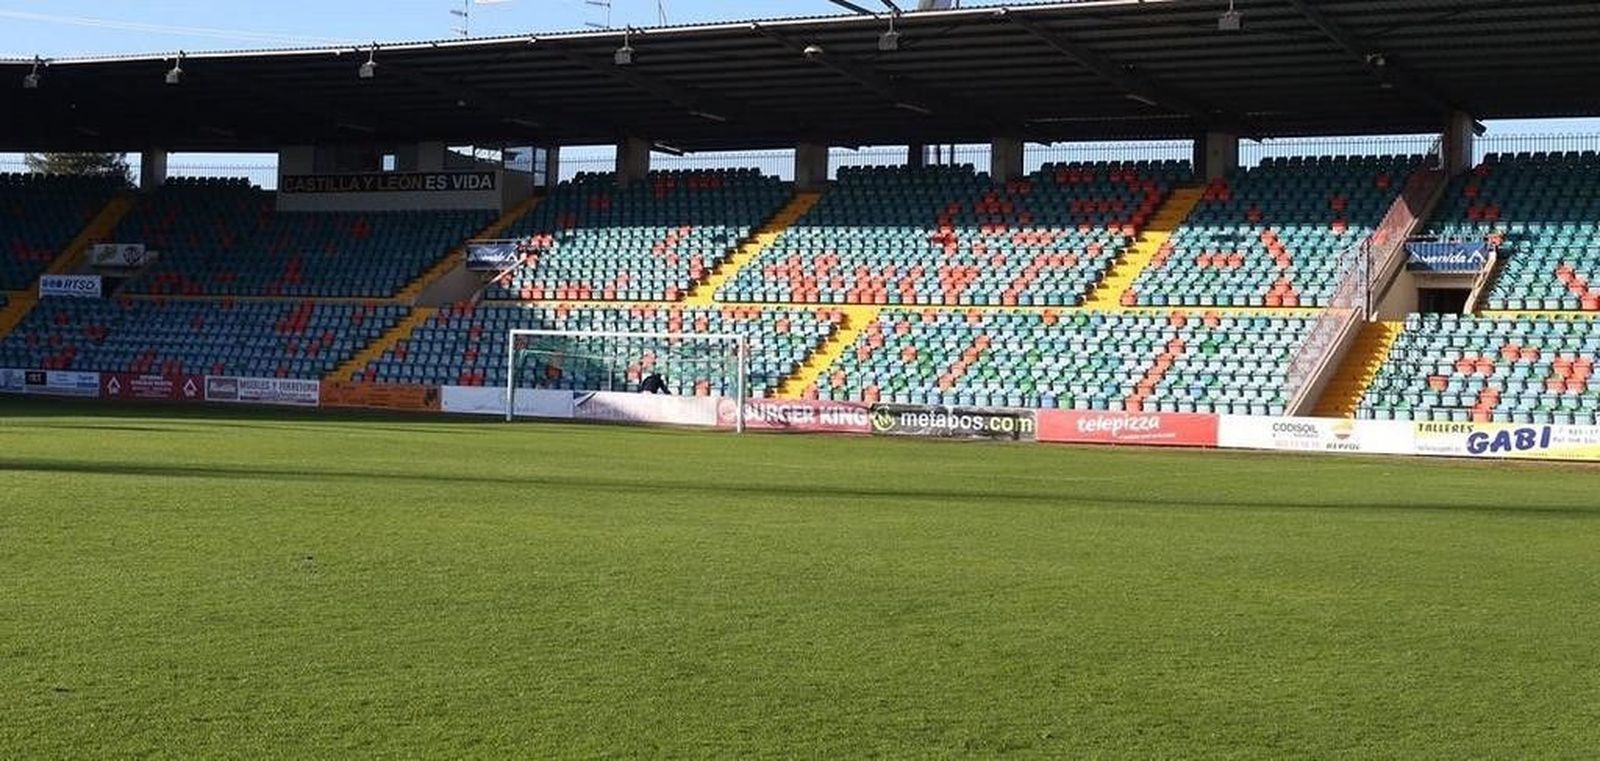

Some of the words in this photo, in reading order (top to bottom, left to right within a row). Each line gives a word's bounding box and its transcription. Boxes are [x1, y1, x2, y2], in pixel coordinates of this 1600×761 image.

[285, 176, 359, 192] CASTILLA
[362, 175, 375, 191] Y
[425, 175, 449, 190] ES
[452, 174, 493, 190] VIDA
[743, 402, 816, 424] BURGER
[820, 405, 867, 426] KING
[900, 410, 1033, 433] metapos.com
[1077, 413, 1161, 437] telepizza
[1418, 423, 1474, 433] TALLERES
[1466, 426, 1551, 454] GABI
